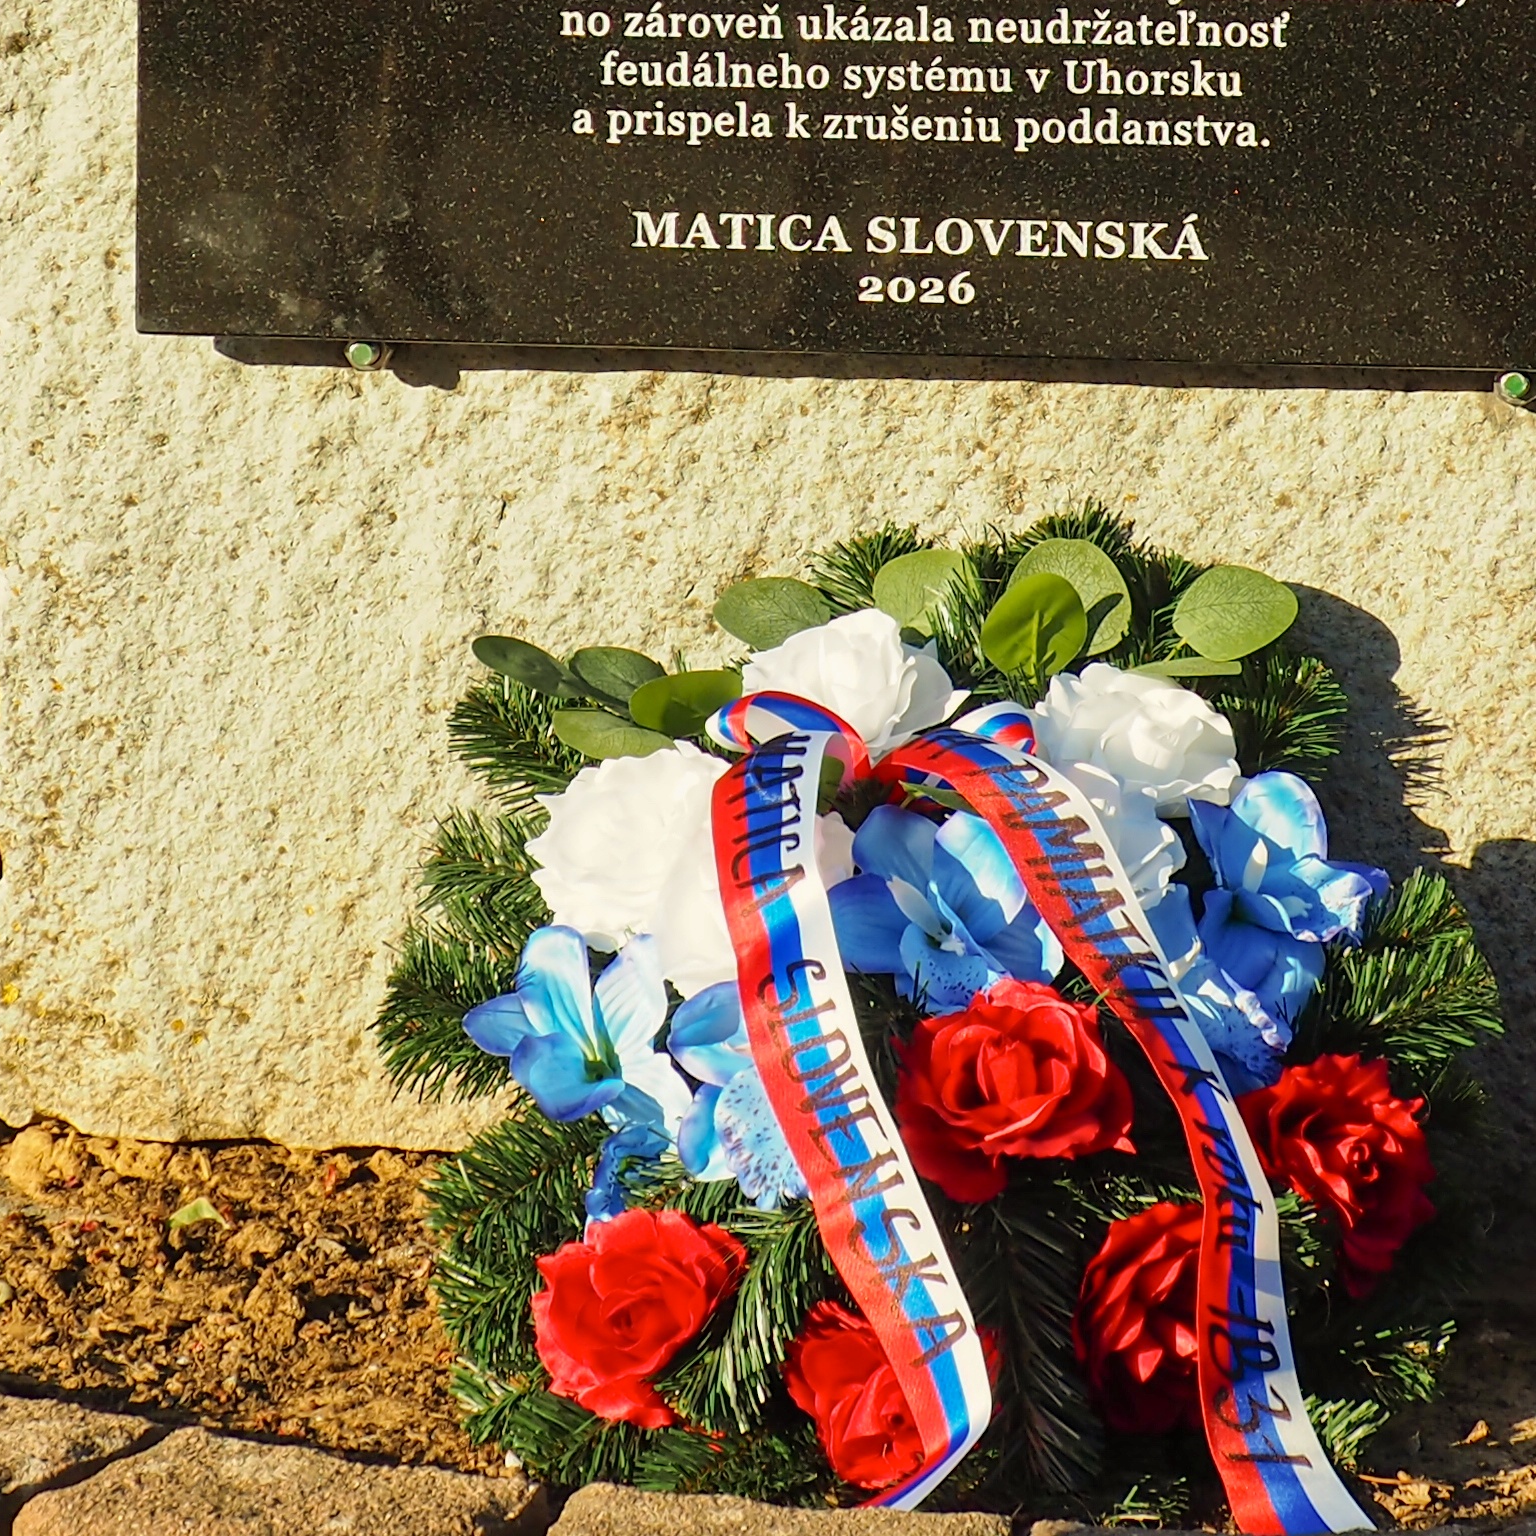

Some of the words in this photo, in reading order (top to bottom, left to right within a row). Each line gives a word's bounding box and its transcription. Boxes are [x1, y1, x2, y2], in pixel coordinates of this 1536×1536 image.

[559, 11, 611, 37] no
[623, 1, 784, 40] zároveň
[796, 3, 955, 43] ukázala
[967, 7, 1291, 48] neudržateľnosť
[599, 49, 830, 90] feudálneho
[843, 55, 1013, 100] systému
[1025, 68, 1051, 94] v
[1063, 57, 1243, 97] Uhorsku
[572, 108, 595, 134] a
[605, 100, 774, 146] prispela
[784, 101, 811, 139] k
[822, 103, 1002, 143] zrušeniu
[1014, 107, 1270, 152] poddanstva.
[631, 210, 853, 253] MATICA
[866, 213, 1210, 261] SLOVENSKÁ
[858, 270, 976, 305] 2026
[725, 729, 812, 918] MATICA
[964, 757, 1191, 1023] PAMIATKU
[756, 958, 967, 1368] SLOVENSKA
